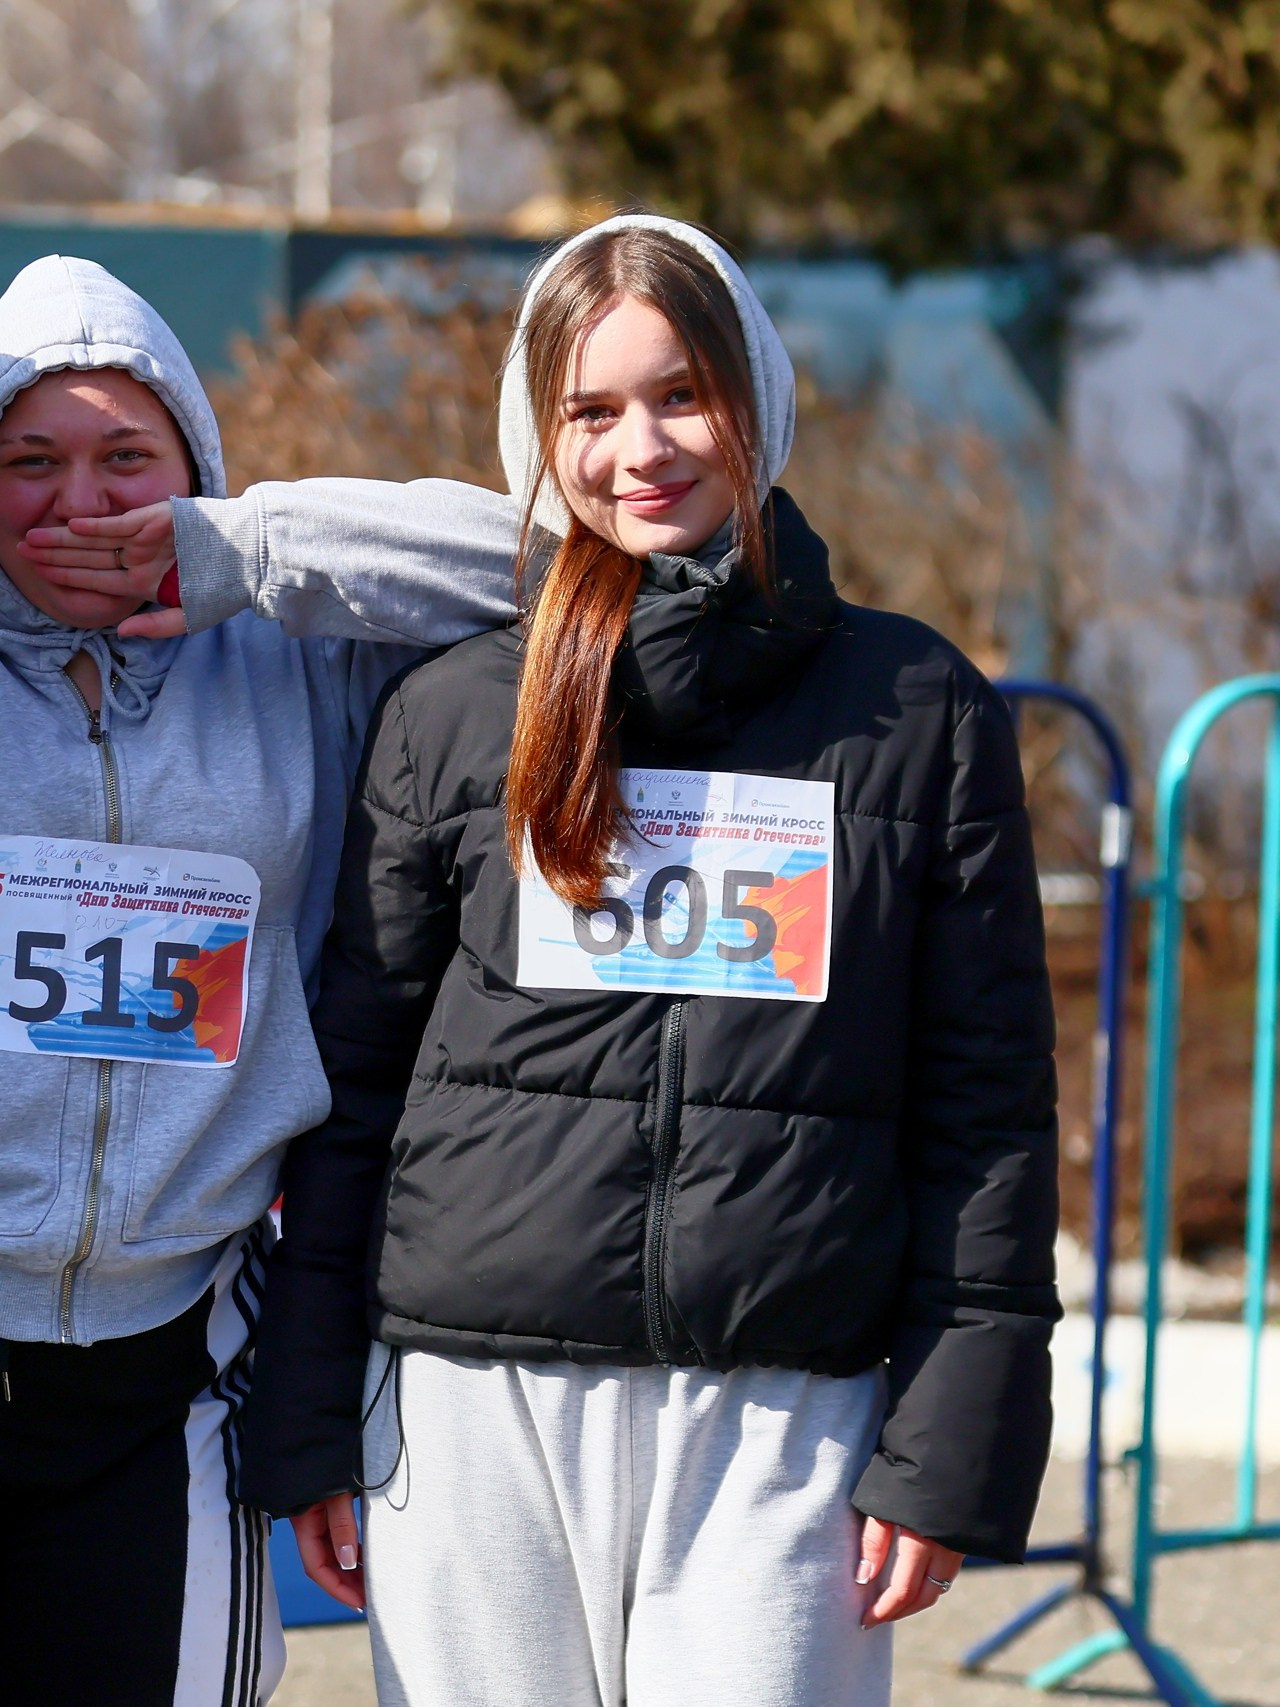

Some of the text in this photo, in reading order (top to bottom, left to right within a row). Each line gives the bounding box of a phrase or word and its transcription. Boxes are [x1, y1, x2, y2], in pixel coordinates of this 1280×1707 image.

[640, 821, 673, 837] «Дню
[676, 822, 750, 840] Защитника
[753, 827, 826, 846] Отечества»
[721, 812, 779, 827] ЗИМНИЙ
[782, 817, 826, 831] КРОСС
[9, 873, 148, 896] МЕЖРЕГИОНАЛЬНЫЙ
[154, 883, 208, 902] ЗИМНИЙ
[208, 889, 252, 906] КРОСС
[76, 891, 110, 909] «Дню
[111, 893, 179, 914] Защитника
[181, 899, 250, 920] Отечества»
[572, 862, 777, 963] 605
[8, 930, 200, 1033] 515
